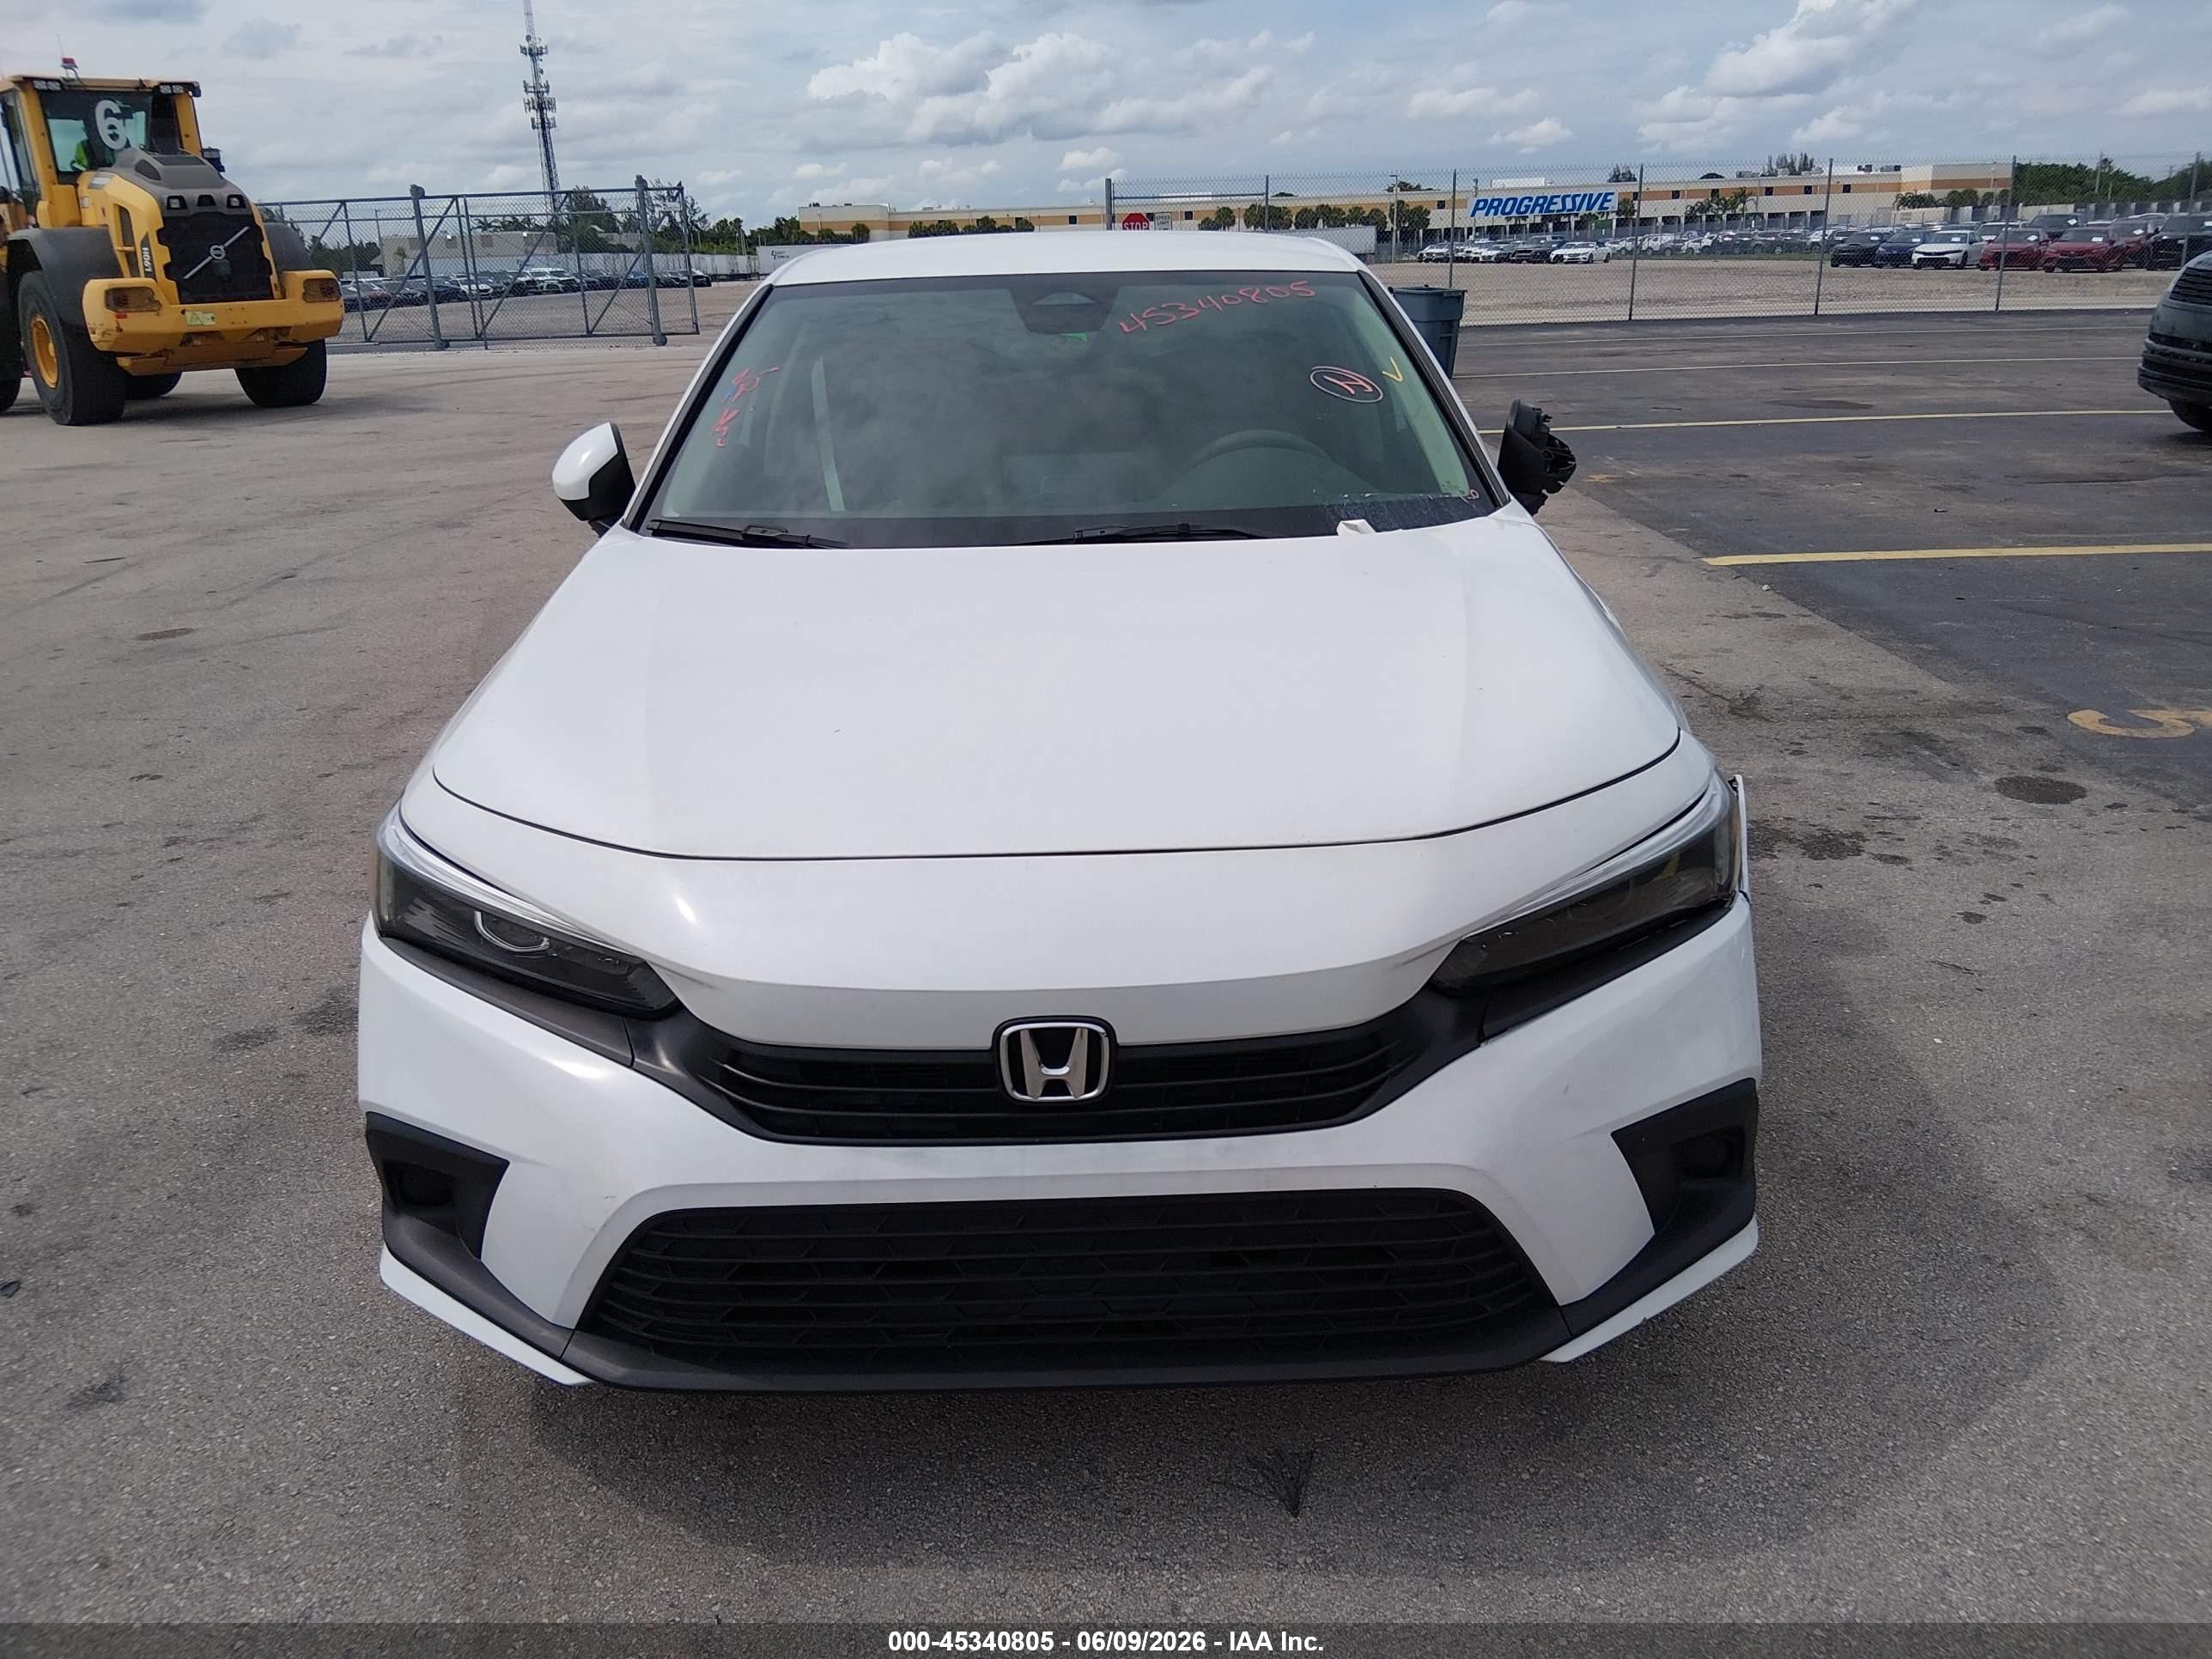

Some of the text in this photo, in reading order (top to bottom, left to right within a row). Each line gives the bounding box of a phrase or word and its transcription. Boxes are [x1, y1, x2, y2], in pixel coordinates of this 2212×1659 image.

[94, 100, 127, 151] 6
[1470, 191, 1615, 217] PROGRESSIVE
[1123, 222, 1149, 231] STOP
[1119, 280, 1316, 334] 45340805
